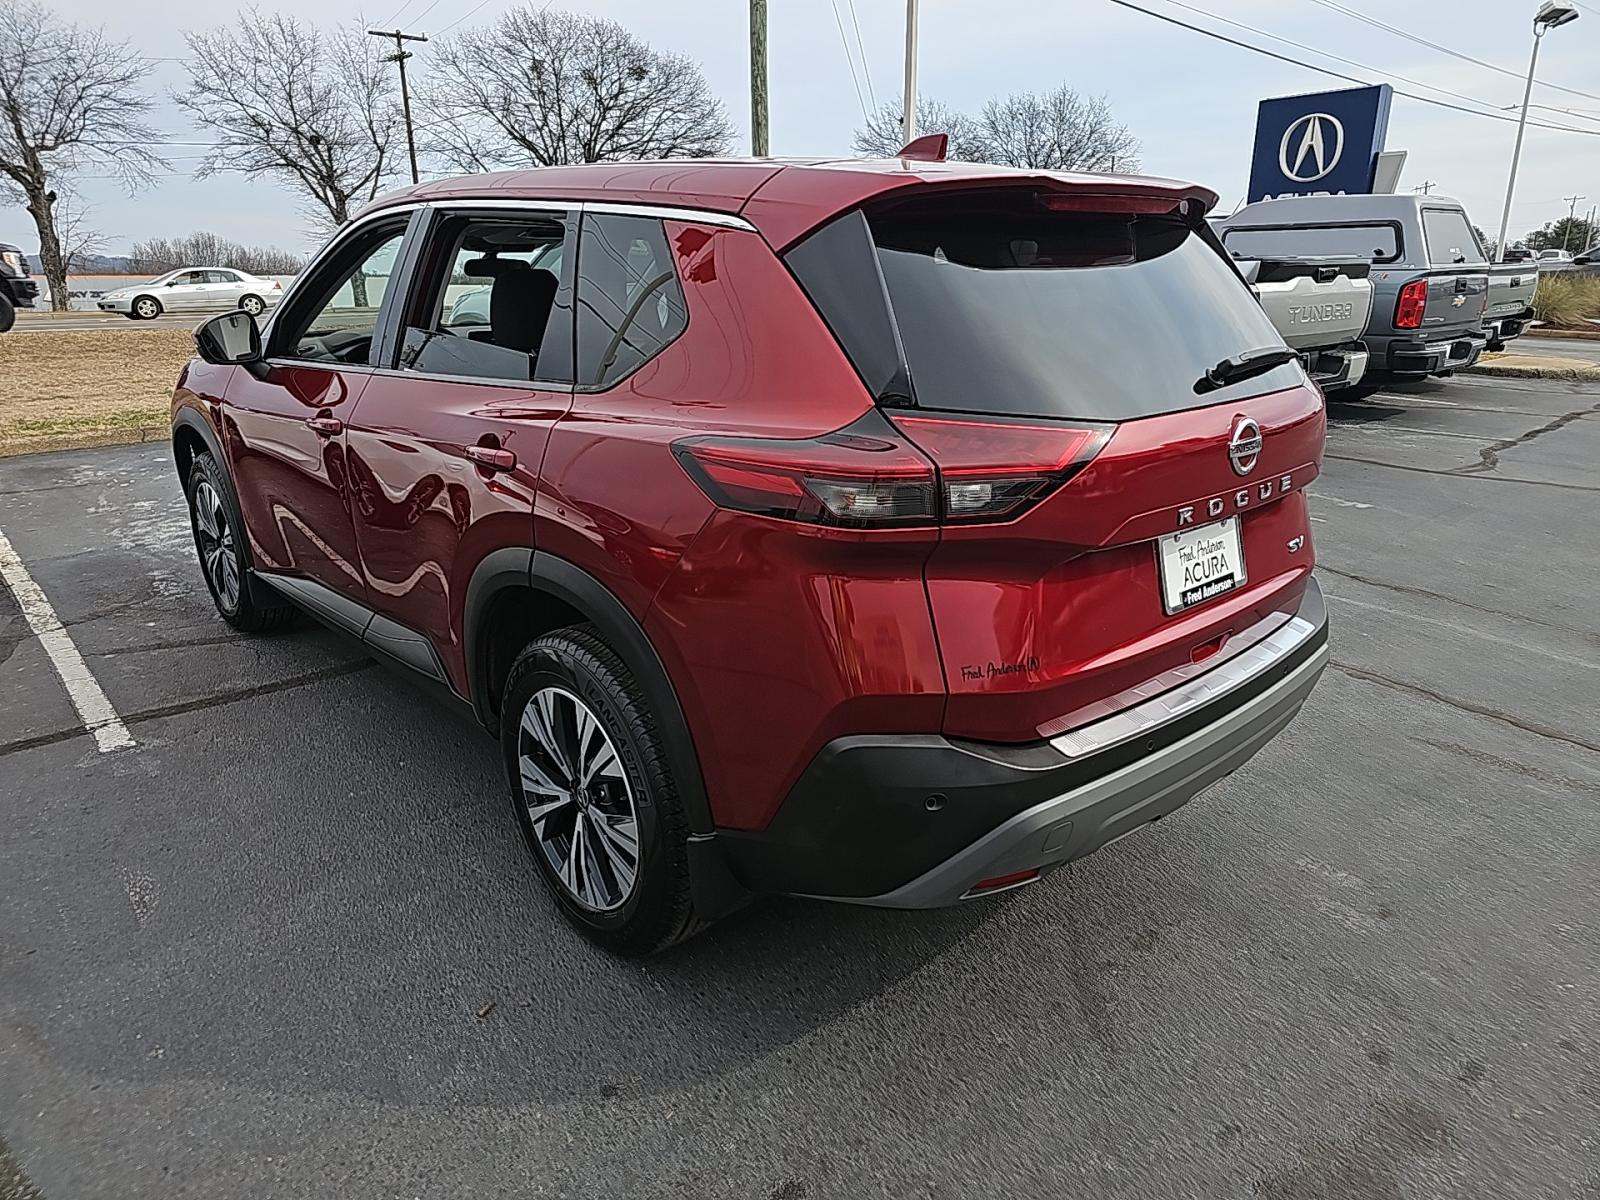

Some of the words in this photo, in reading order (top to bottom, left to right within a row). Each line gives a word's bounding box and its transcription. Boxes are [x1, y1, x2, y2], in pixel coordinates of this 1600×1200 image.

[1288, 303, 1352, 325] TUNDRA
[1233, 439, 1261, 455] NISSAN
[1177, 475, 1292, 526] ROGUE
[1286, 535, 1304, 554] SV
[1178, 545, 1197, 566] Fred
[1183, 553, 1229, 588] ACURA
[1186, 587, 1203, 605] Fred
[1202, 579, 1231, 598] Anderson
[961, 665, 985, 682] Fred
[987, 661, 1026, 679] Anderson
